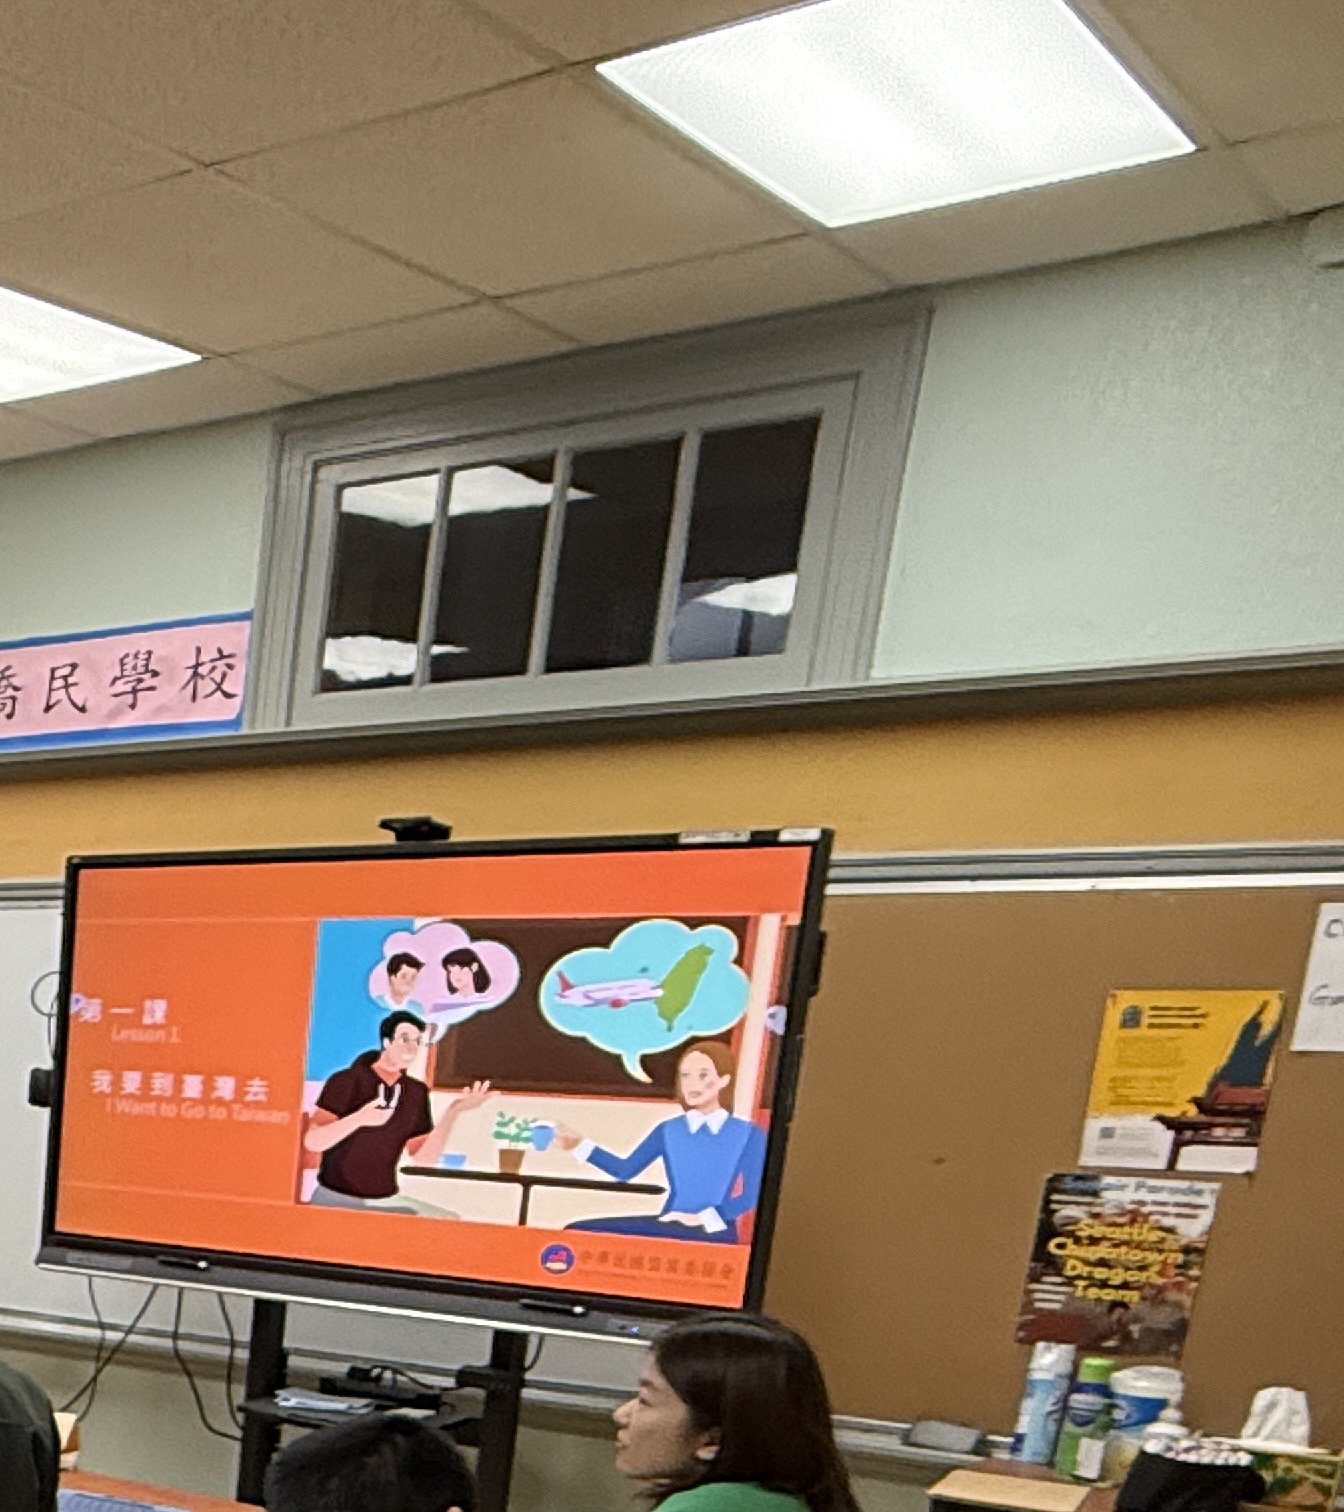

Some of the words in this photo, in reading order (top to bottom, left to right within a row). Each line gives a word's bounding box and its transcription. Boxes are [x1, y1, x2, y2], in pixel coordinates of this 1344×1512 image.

[112, 1024, 166, 1043] Lesson
[91, 1069, 270, 1102] 我要到臺灣去
[116, 1099, 157, 1117] Want
[160, 1101, 178, 1118] to
[181, 1101, 206, 1120] Go
[208, 1104, 228, 1121] to
[232, 1104, 291, 1124] Taiwan
